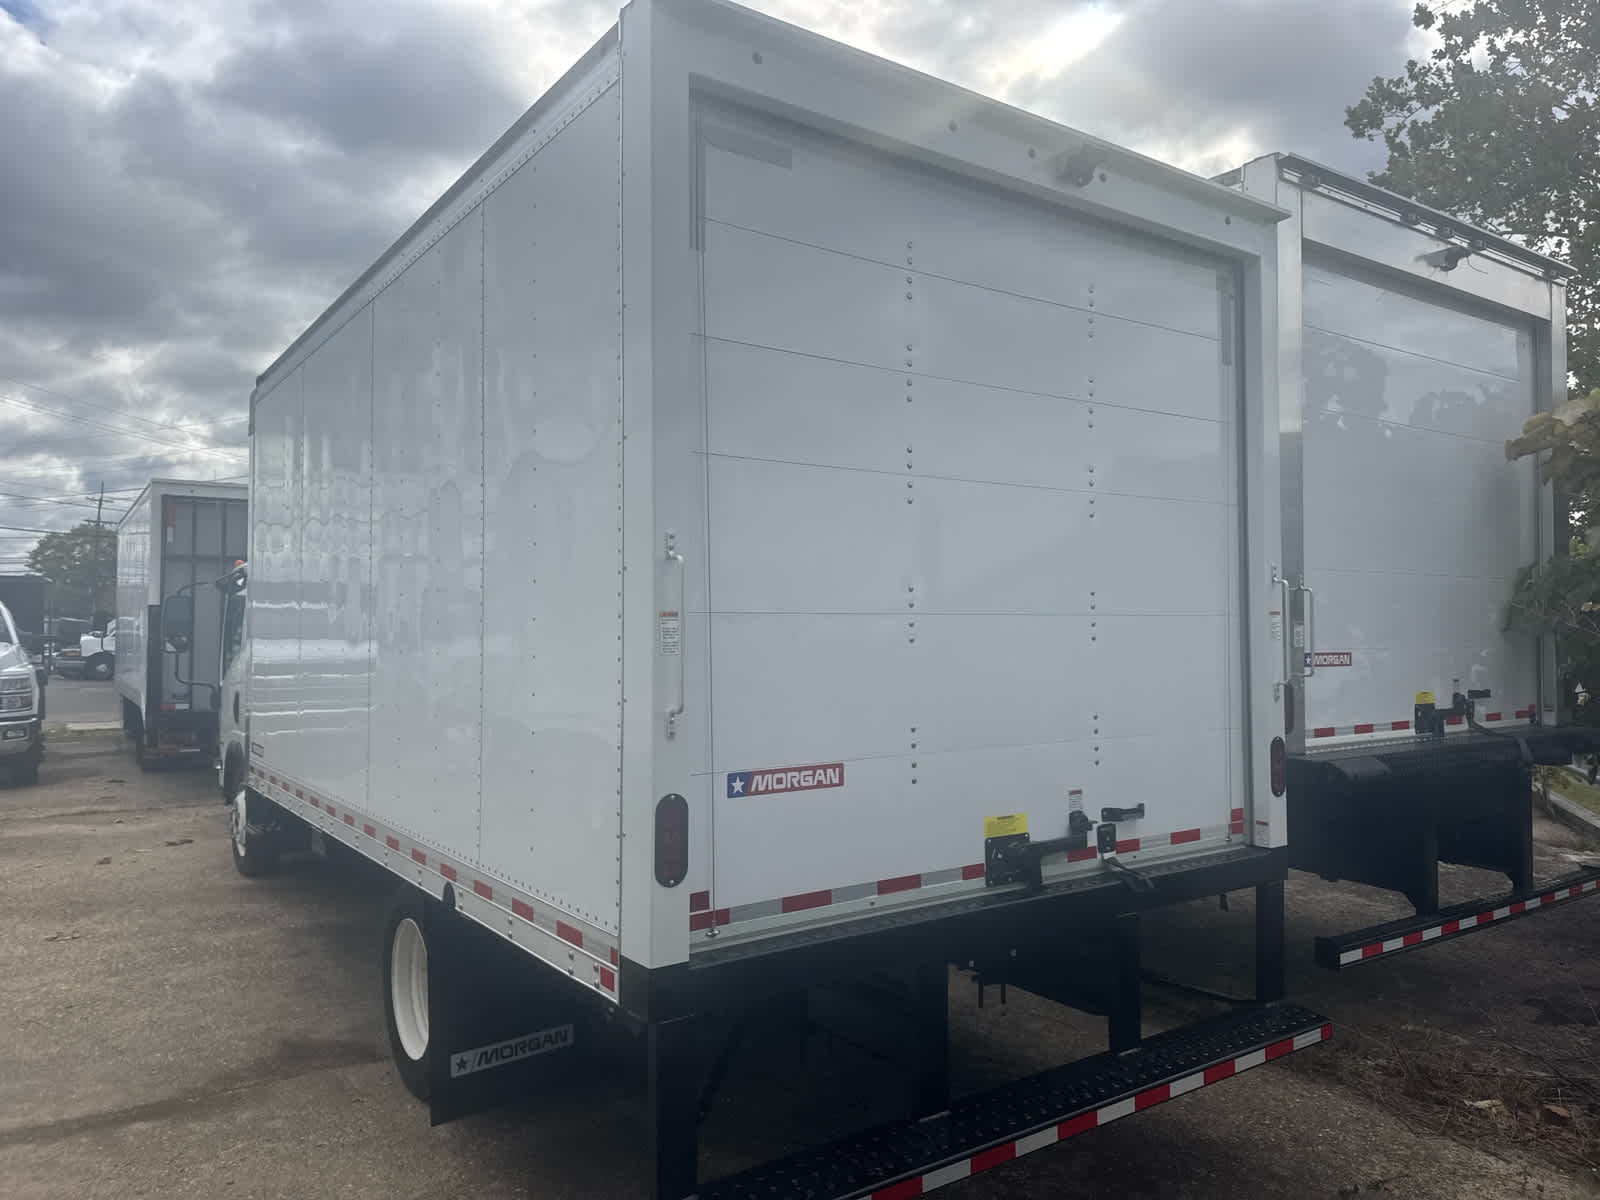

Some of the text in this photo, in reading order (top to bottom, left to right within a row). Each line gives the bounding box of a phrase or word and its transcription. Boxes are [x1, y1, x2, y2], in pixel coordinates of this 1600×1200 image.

[1314, 654, 1351, 665] MORGAN
[750, 767, 840, 793] MORGAN
[476, 1028, 569, 1067] MORGAN
